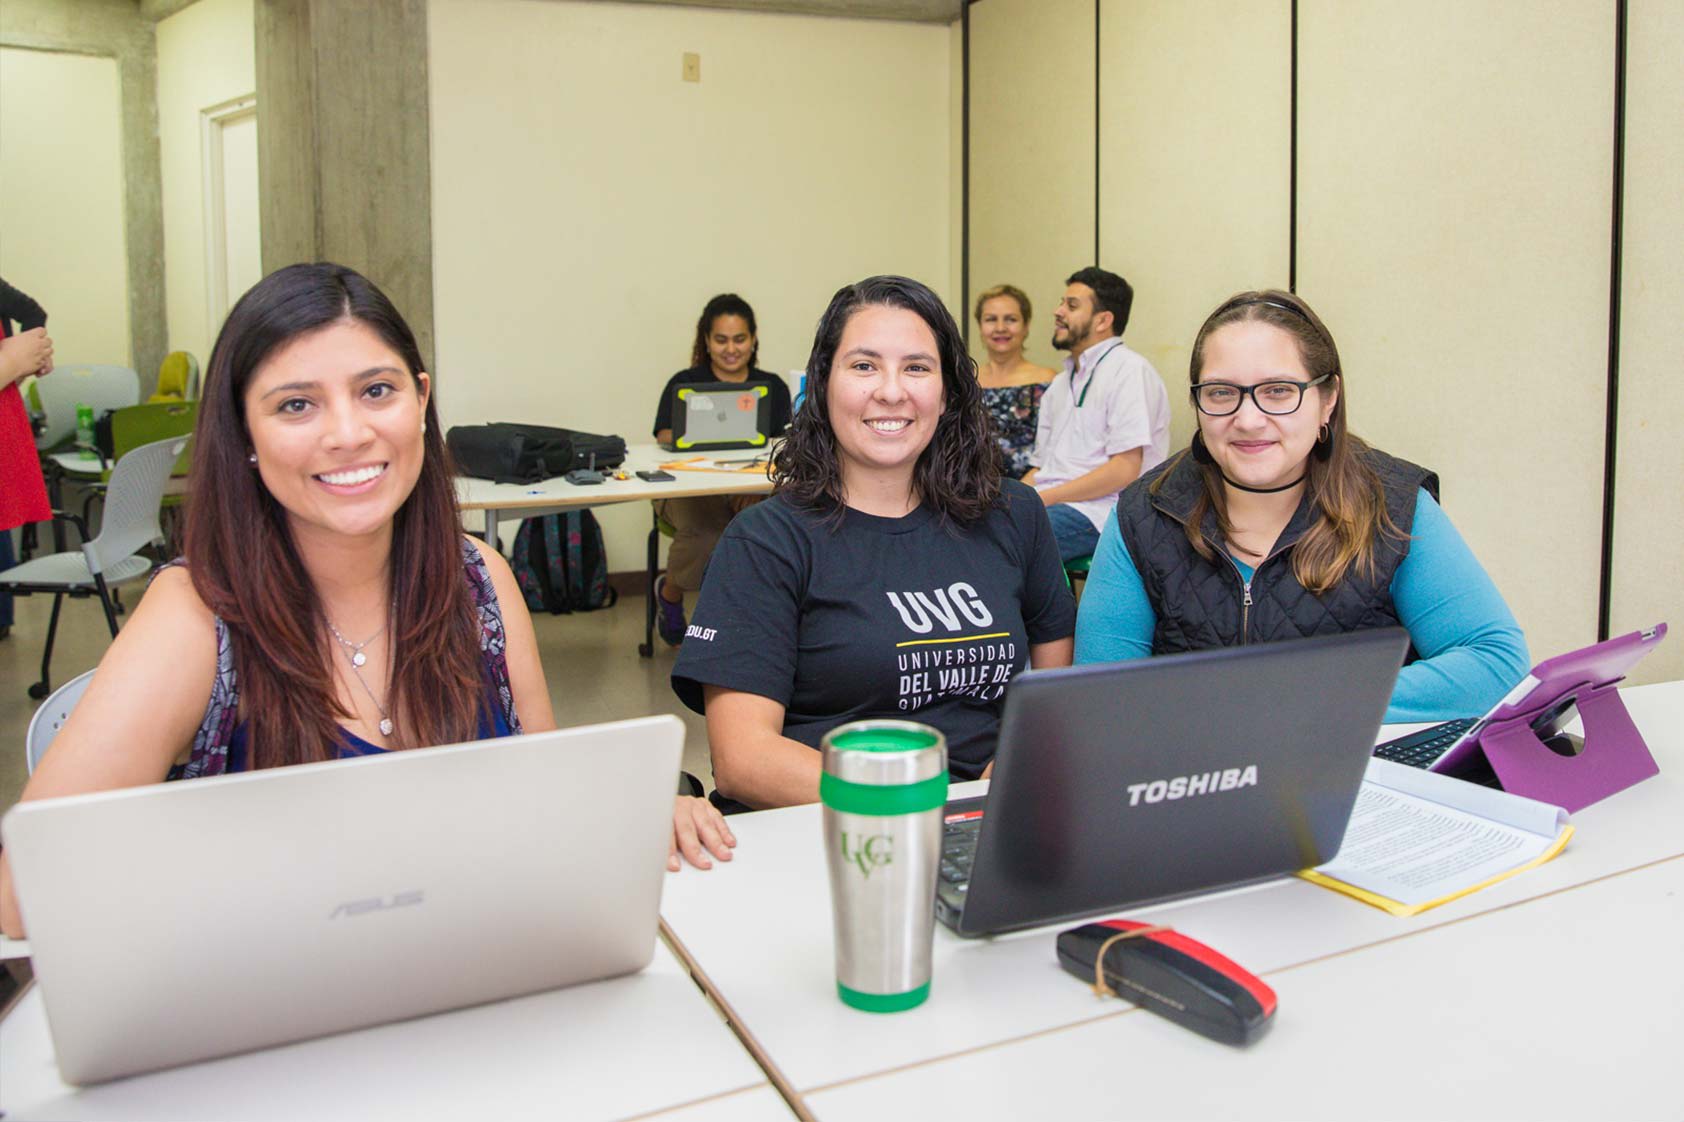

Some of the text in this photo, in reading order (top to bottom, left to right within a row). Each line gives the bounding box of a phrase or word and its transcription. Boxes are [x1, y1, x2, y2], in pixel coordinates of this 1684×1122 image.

[886, 582, 993, 633] UVG
[898, 643, 1015, 672] UNIVERSIDAD
[900, 663, 1013, 695] DEL VALLE DE
[1127, 765, 1258, 807] TOSHIBA
